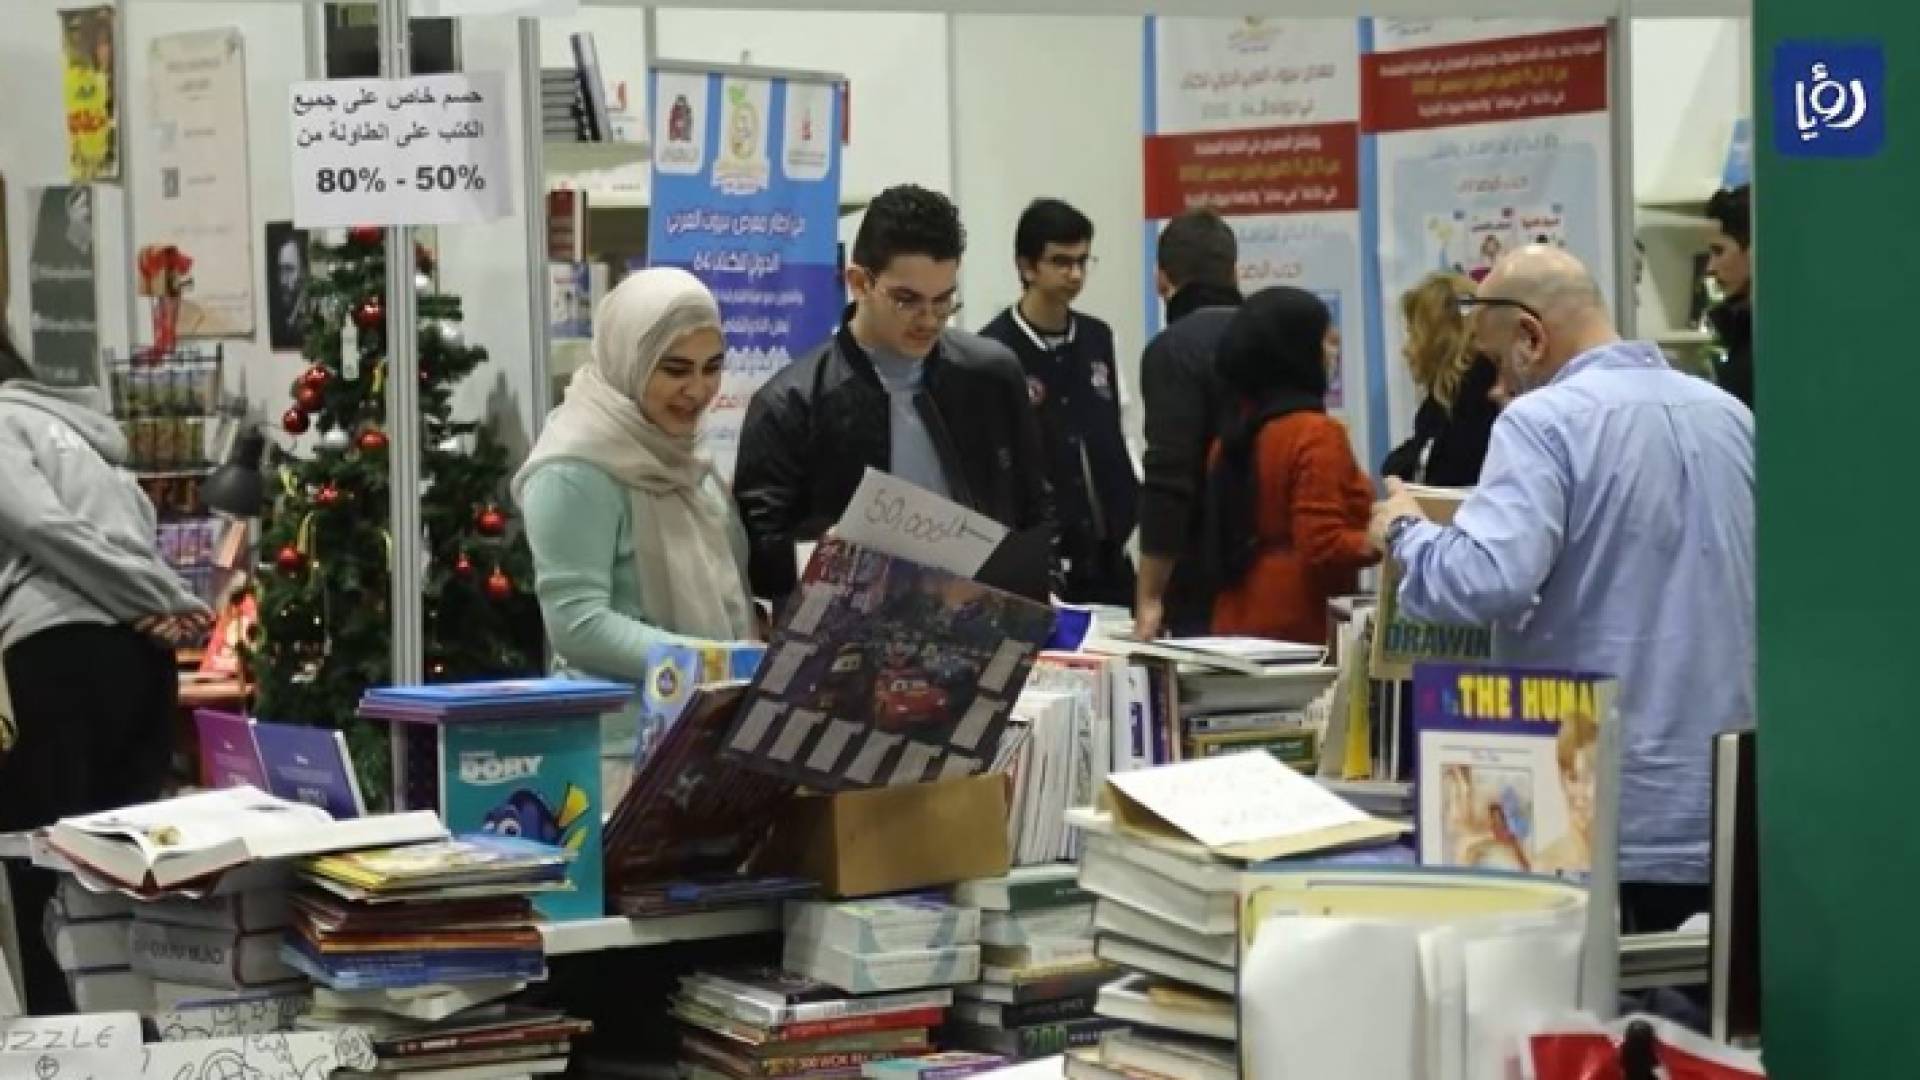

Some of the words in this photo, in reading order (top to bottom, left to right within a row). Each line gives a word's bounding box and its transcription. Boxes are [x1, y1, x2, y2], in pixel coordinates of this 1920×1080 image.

[293, 93, 337, 116] جميع
[342, 87, 378, 114] على
[386, 86, 435, 110] خاص
[442, 90, 483, 110] حسم
[296, 129, 322, 147] من
[328, 121, 389, 147] الطاولة
[396, 121, 430, 148] على
[437, 120, 484, 144] الكتب
[316, 165, 387, 193] 80%
[415, 163, 486, 190] 50%
[1458, 675, 1513, 720] THE
[460, 755, 543, 784] DORY
